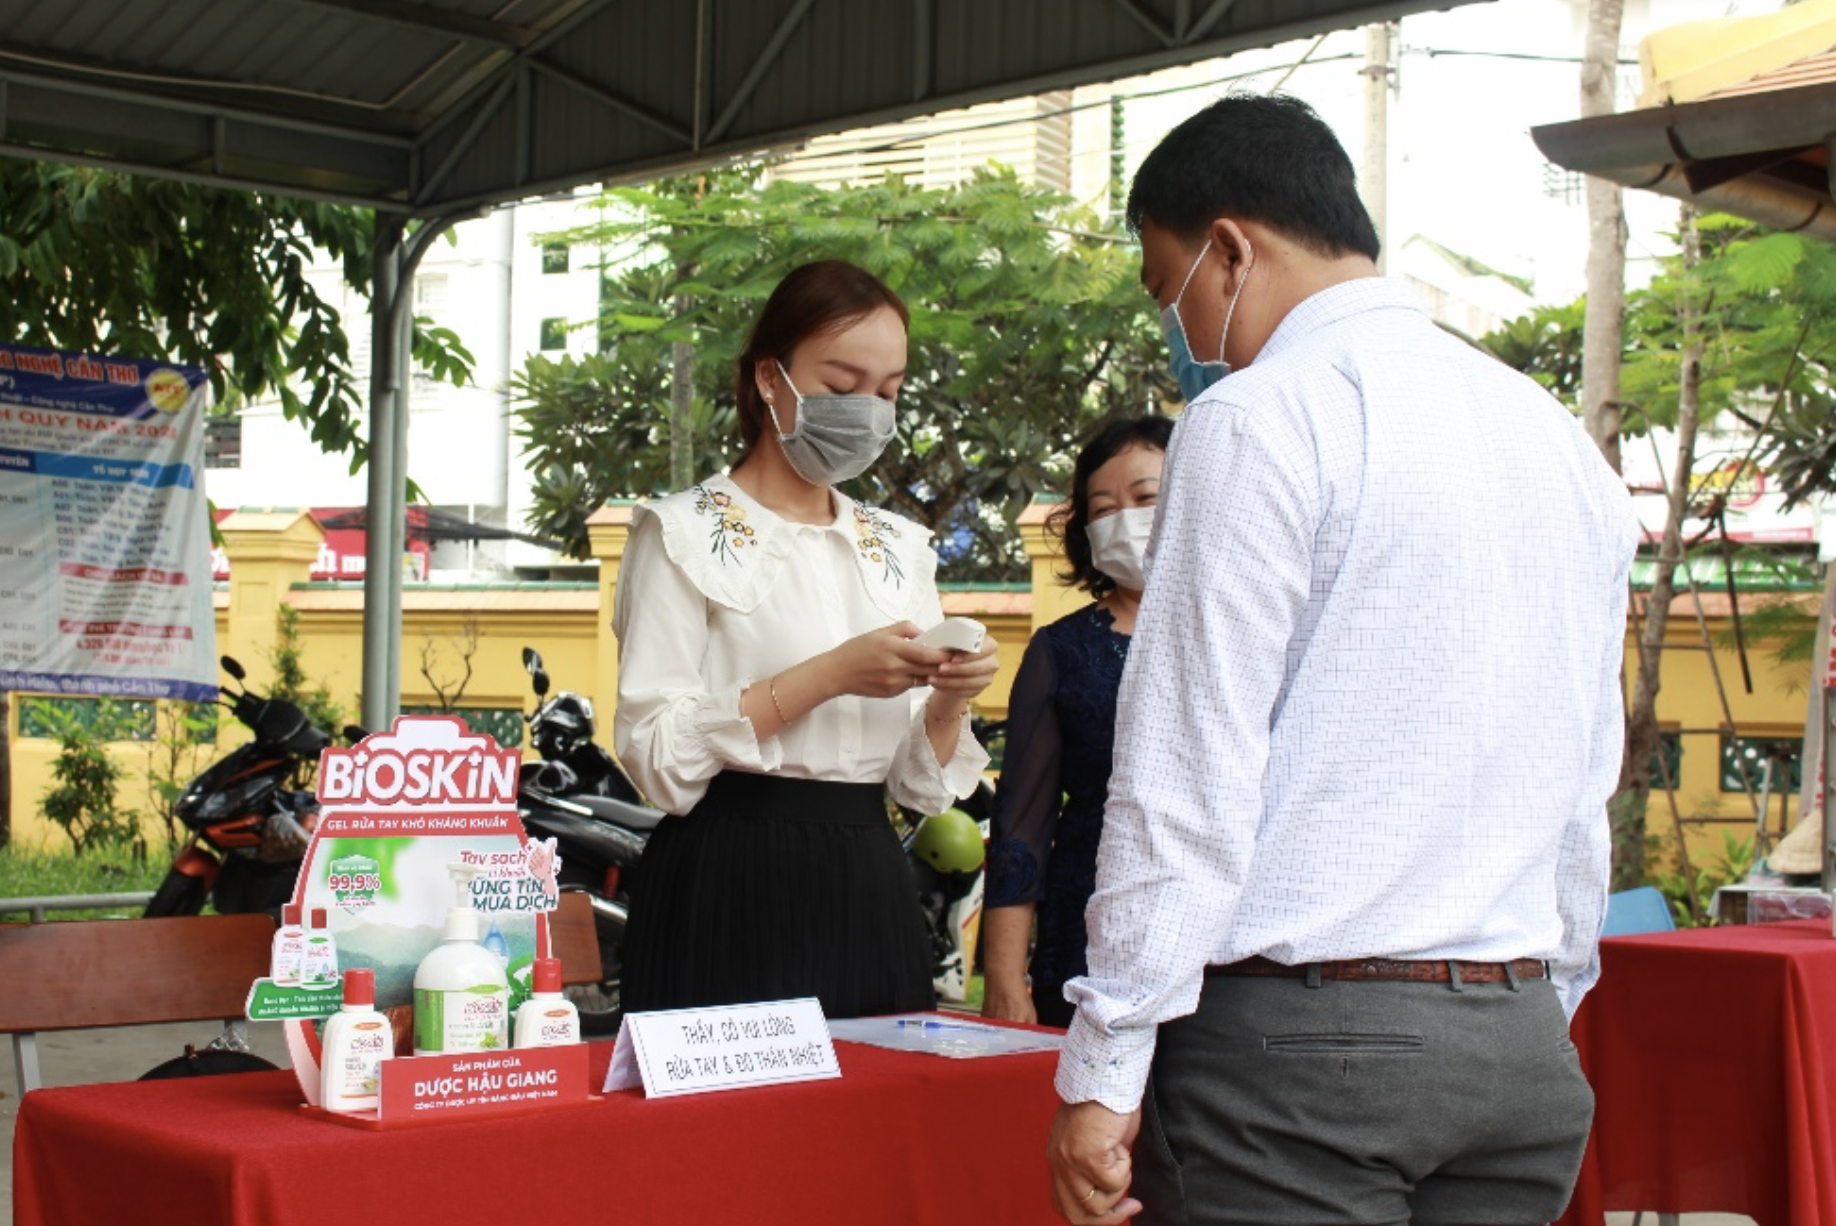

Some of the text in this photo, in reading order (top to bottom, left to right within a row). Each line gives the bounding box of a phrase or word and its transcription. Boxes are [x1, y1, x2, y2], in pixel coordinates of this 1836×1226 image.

[15, 353, 64, 380] NGHỆ
[18, 409, 68, 427] QUY
[327, 819, 348, 831] GEL
[378, 819, 399, 830] TAY
[428, 816, 467, 830] KHÁNG
[468, 877, 512, 895] ỮNG
[516, 894, 556, 912] DỊCH
[721, 1017, 739, 1042] CÔ
[740, 1018, 762, 1039] VUI
[763, 1013, 796, 1037] LÒNG
[666, 1054, 693, 1081] RỬA
[694, 1055, 718, 1076] TAY
[723, 1055, 734, 1074] &
[754, 1046, 788, 1070] THÂN
[788, 1042, 824, 1067] NHIỆT
[414, 1069, 557, 1099] DƯỢC HẬU GIANG
